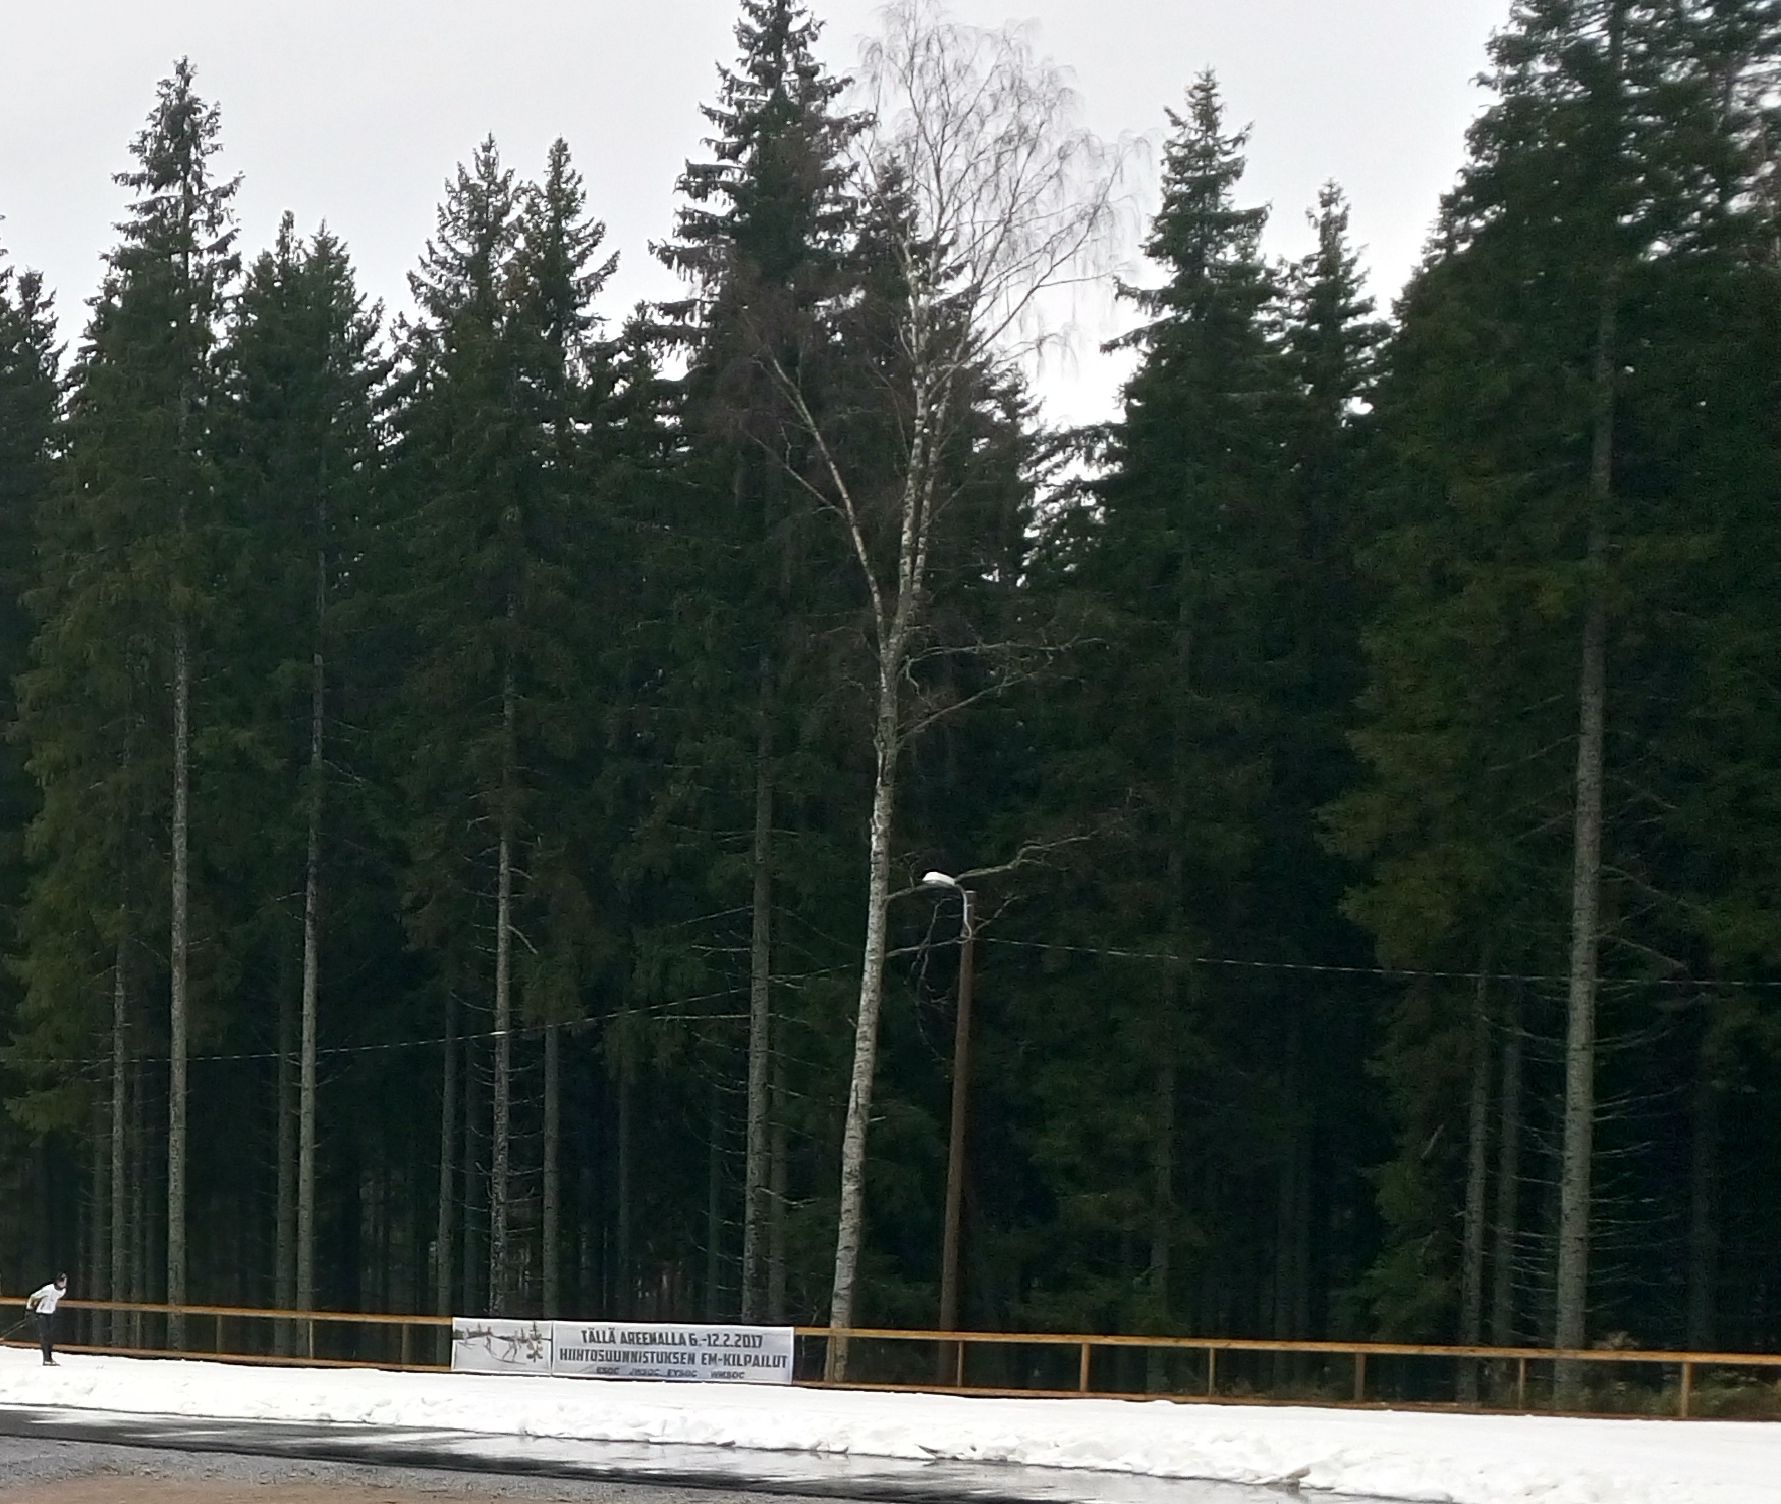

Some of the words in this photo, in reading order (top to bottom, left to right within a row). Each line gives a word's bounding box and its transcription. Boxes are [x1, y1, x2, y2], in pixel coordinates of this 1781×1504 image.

[581, 1327, 616, 1344] TÄLLÄ
[620, 1330, 687, 1347] AREENALLA
[559, 1347, 696, 1365] HIIHTOSUUNNISTUKSEN
[701, 1351, 789, 1369] EM-KILPAILUT
